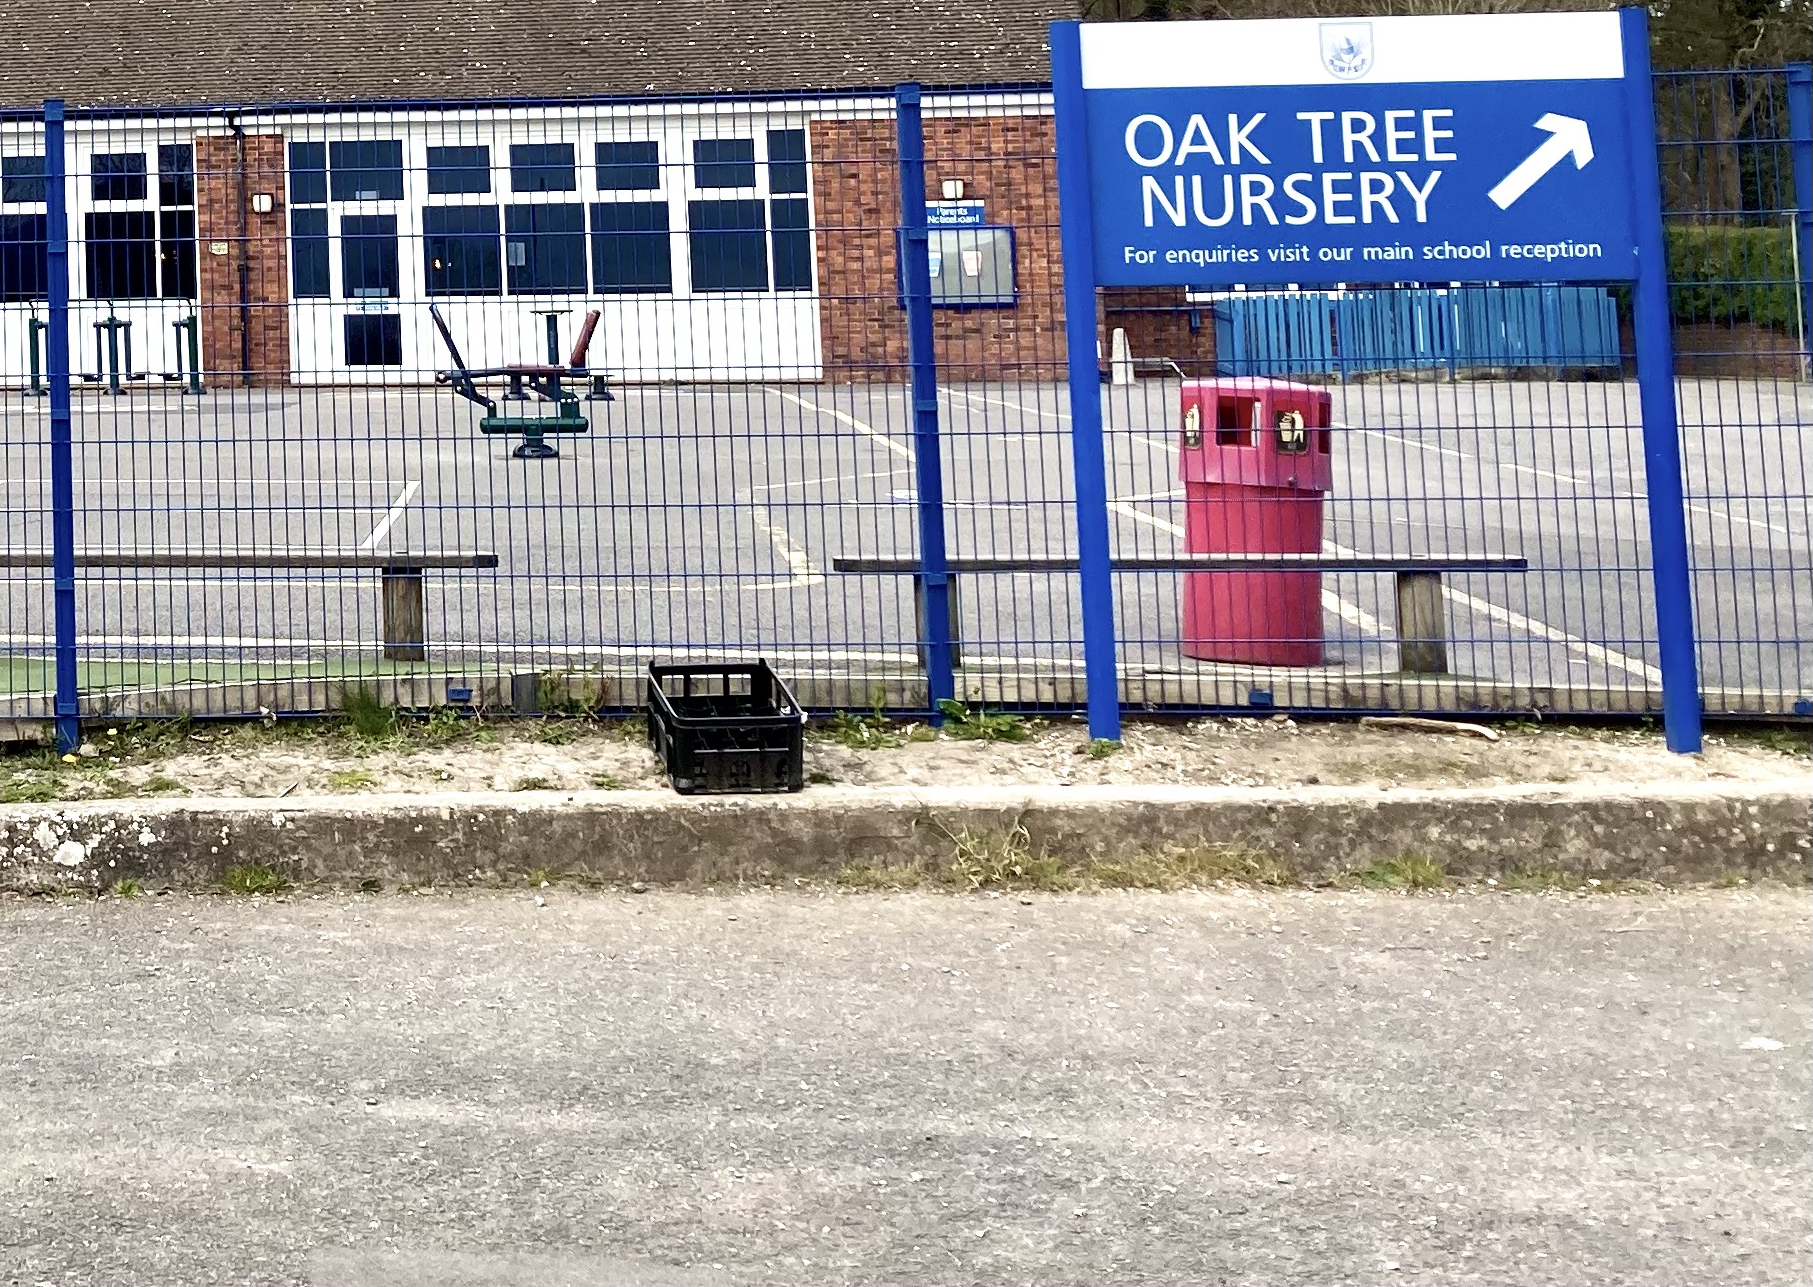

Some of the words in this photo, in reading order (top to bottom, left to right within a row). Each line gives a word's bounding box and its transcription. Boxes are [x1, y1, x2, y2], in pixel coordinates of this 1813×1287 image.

[1125, 113, 1271, 167] OAK
[1296, 109, 1457, 163] TREE
[1142, 170, 1442, 227] NURSERY
[1124, 246, 1156, 264] For
[1165, 245, 1259, 267] enquiries
[1267, 244, 1310, 262] visit
[1318, 246, 1353, 261] our
[1363, 242, 1413, 260] main
[1423, 241, 1490, 260] school
[1500, 240, 1602, 262] reception
